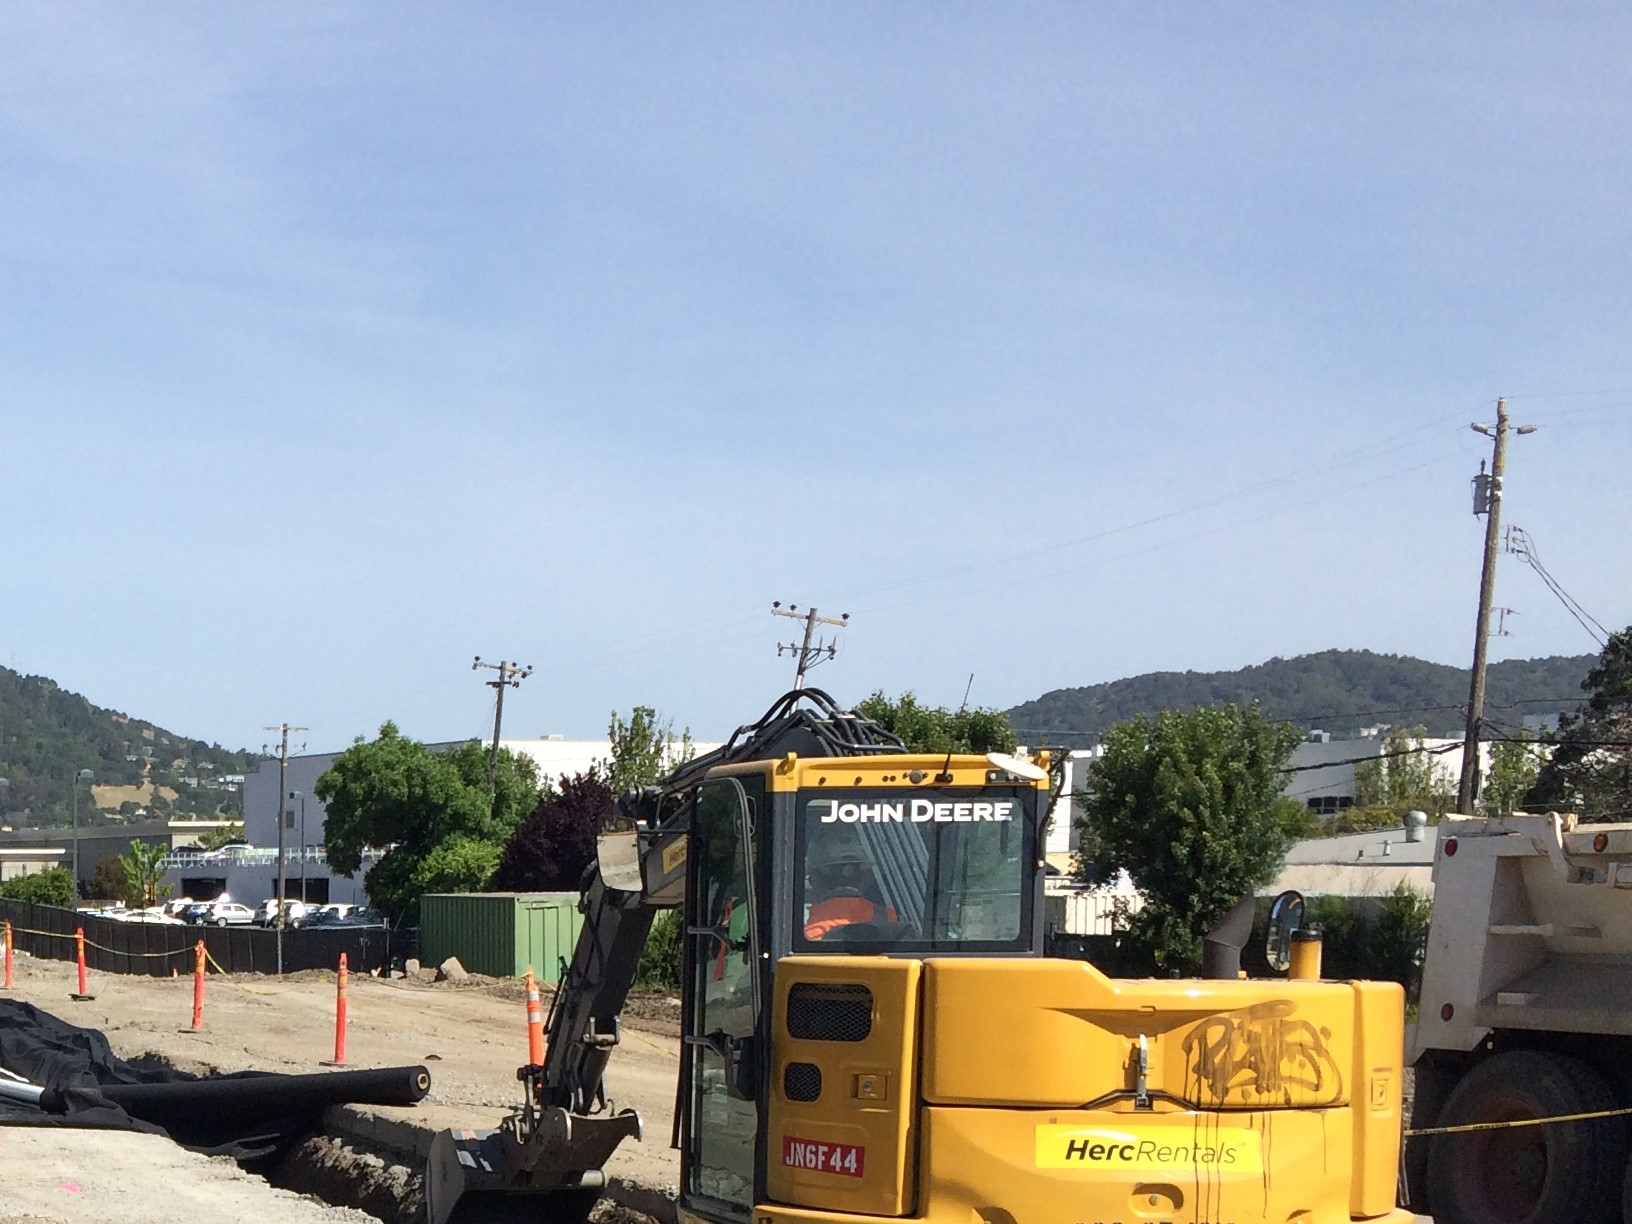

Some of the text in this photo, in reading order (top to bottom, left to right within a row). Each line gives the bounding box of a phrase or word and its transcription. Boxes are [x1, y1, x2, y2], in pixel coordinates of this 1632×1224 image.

[821, 799, 1014, 823] JOHN DEERE
[785, 1142, 858, 1174] JN6F44
[1064, 1139, 1238, 1164] HercRentals
